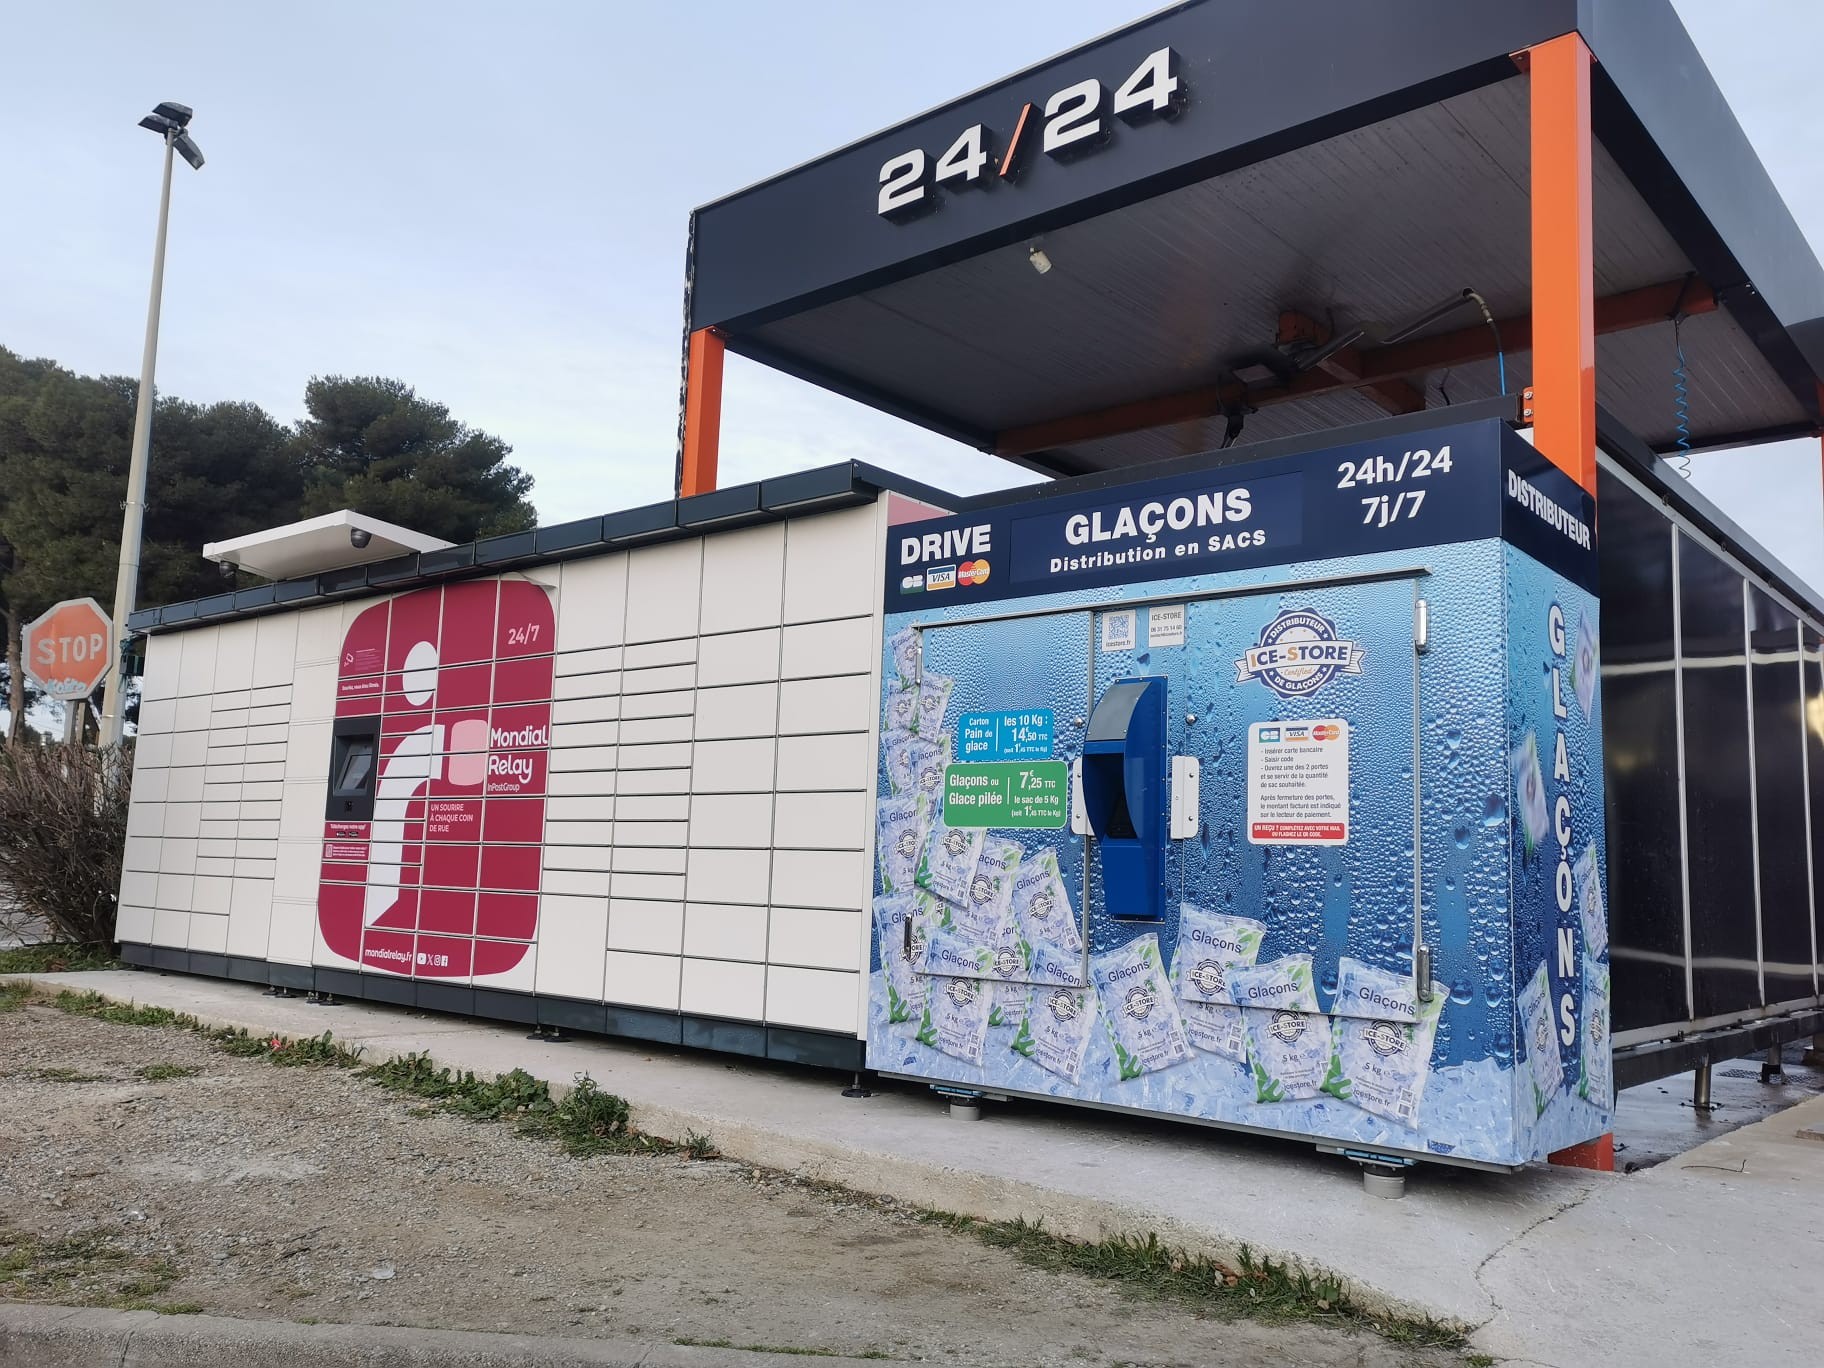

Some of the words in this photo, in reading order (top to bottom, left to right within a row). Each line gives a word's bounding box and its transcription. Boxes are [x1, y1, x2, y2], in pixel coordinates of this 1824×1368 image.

[878, 46, 1178, 215] 24/24
[1337, 446, 1452, 488] 24h/24
[1065, 488, 1252, 543] GLAÇONS
[1361, 490, 1426, 528] 7j/7
[1508, 468, 1591, 551] DISTRIBUTEUR
[901, 524, 991, 565] DRIVE
[1050, 546, 1166, 573] Distribution
[1174, 541, 1199, 555] en
[1208, 530, 1266, 552] SACS
[932, 573, 951, 583] VISA
[1152, 612, 1182, 621] ICE-STORE
[507, 623, 540, 645] 24/7
[1270, 617, 1325, 638] DISTRIBUTEUR
[36, 633, 103, 665] STOP
[1251, 645, 1348, 668] ICE-STORE
[1274, 676, 1283, 687] DE
[1285, 673, 1323, 690] GLAÇONS
[969, 718, 989, 726] Carton
[1004, 716, 1016, 726] les
[1018, 716, 1029, 725] 10
[1031, 714, 1043, 726] Kg
[490, 725, 548, 747] Mondial
[965, 729, 982, 739] Pain
[984, 730, 992, 738] de
[965, 741, 988, 754] glace
[488, 755, 533, 784] Relay
[1305, 772, 1328, 780] quantité
[949, 774, 989, 789] Glaçons
[1044, 780, 1056, 788] TTC
[949, 793, 976, 805] Glace
[978, 792, 1002, 807] pilée
[1050, 795, 1059, 805] Kg
[435, 814, 458, 823] CHAQUE
[889, 809, 917, 822] Glaço
[438, 825, 449, 833] RUE
[1548, 605, 1576, 1047] GLAÇONS
[978, 854, 1007, 870] açons
[1016, 870, 1050, 890] Glaçons
[971, 884, 994, 898] CE-STORE
[891, 907, 924, 924] Glans
[1191, 929, 1242, 954] Glaçons
[364, 949, 412, 963] mondialrelay.fr
[941, 949, 981, 971] Glaçons
[1108, 961, 1150, 982] Glaçons
[1248, 981, 1298, 1000] Glaçons
[1359, 987, 1416, 1016] Glaçons
